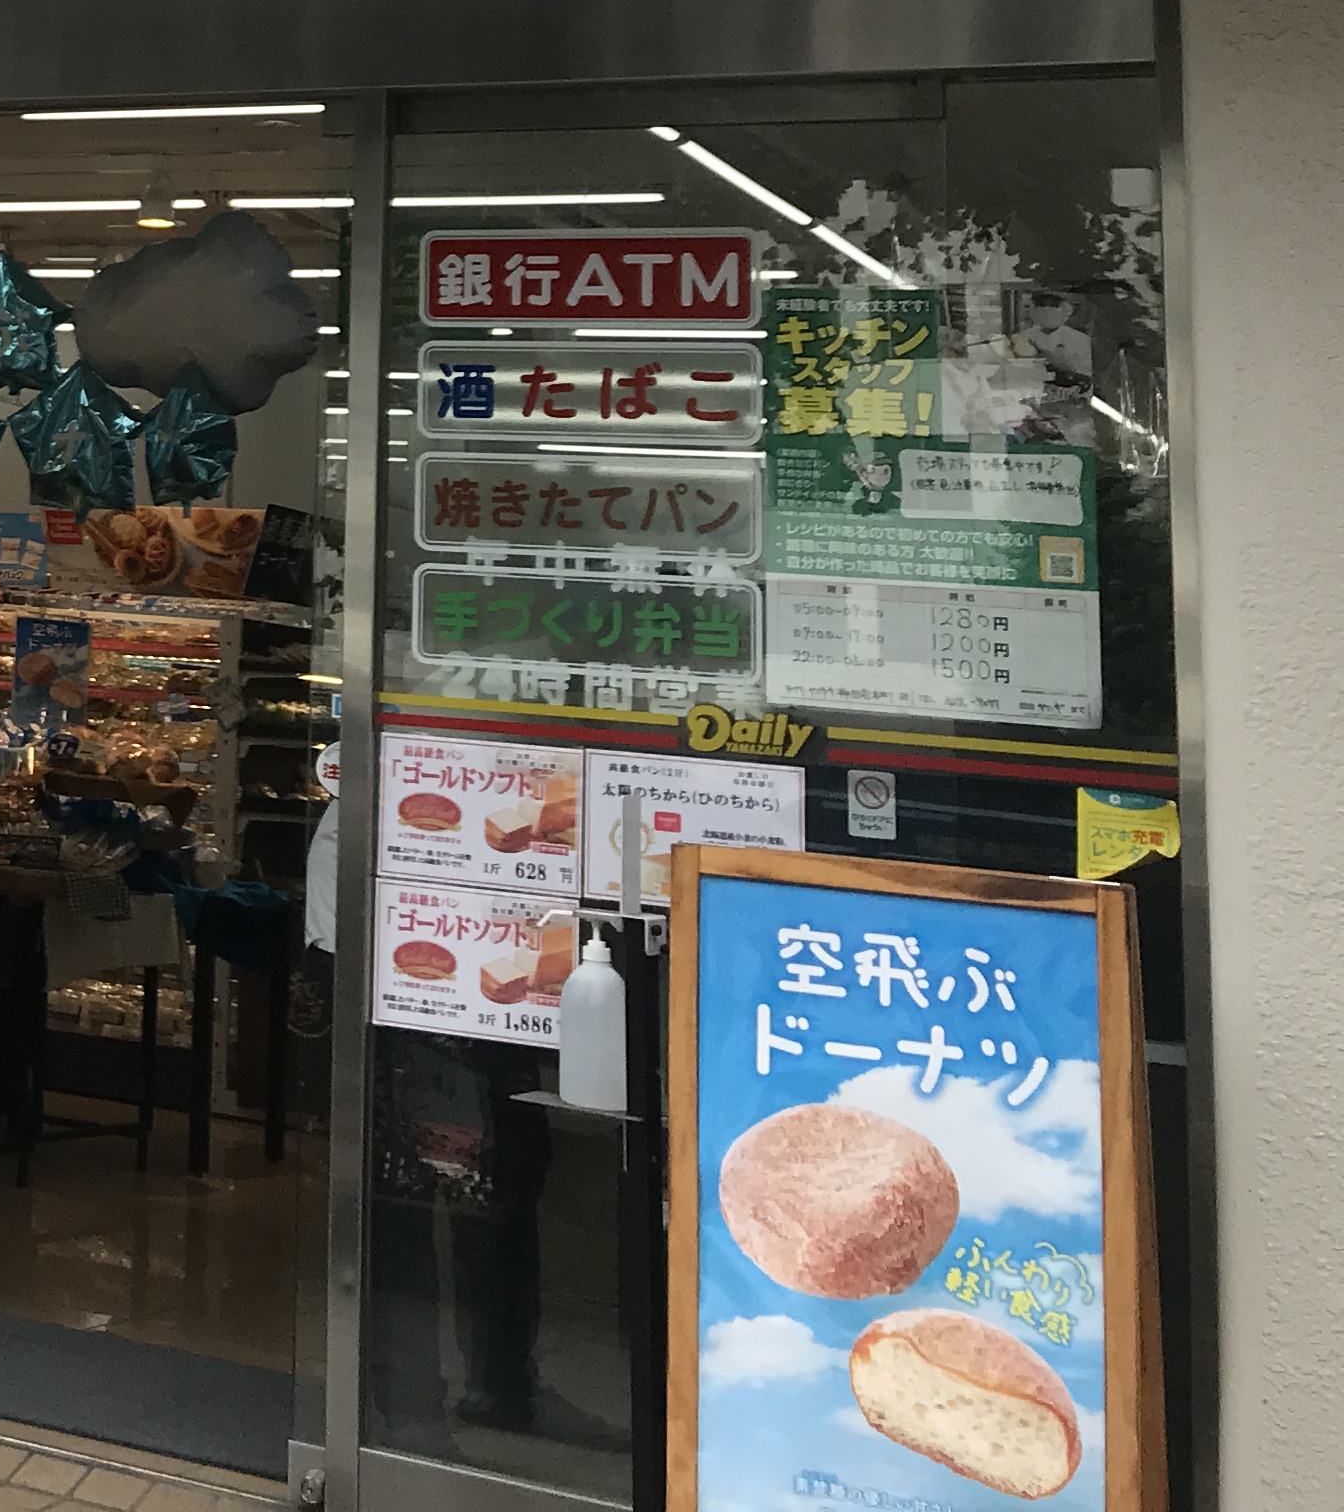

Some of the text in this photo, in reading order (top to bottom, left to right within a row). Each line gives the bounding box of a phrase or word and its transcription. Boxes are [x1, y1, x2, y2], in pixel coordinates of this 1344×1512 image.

[436, 252, 741, 309] 銀行ATM
[776, 316, 930, 357] キッチン
[437, 361, 741, 424] 酒 たばこ
[792, 356, 915, 386] スタッフ
[777, 386, 934, 437] 募集!
[433, 476, 741, 534] 焼きたてパン
[432, 590, 742, 658] 手づくり弁当
[686, 704, 812, 758] Daily
[515, 861, 548, 882] 628
[777, 923, 1017, 1013] 空飛ぶ
[503, 1011, 553, 1036] 1,886
[756, 1003, 1050, 1107] ドーナツ
[955, 1236, 1070, 1307] ふんわり
